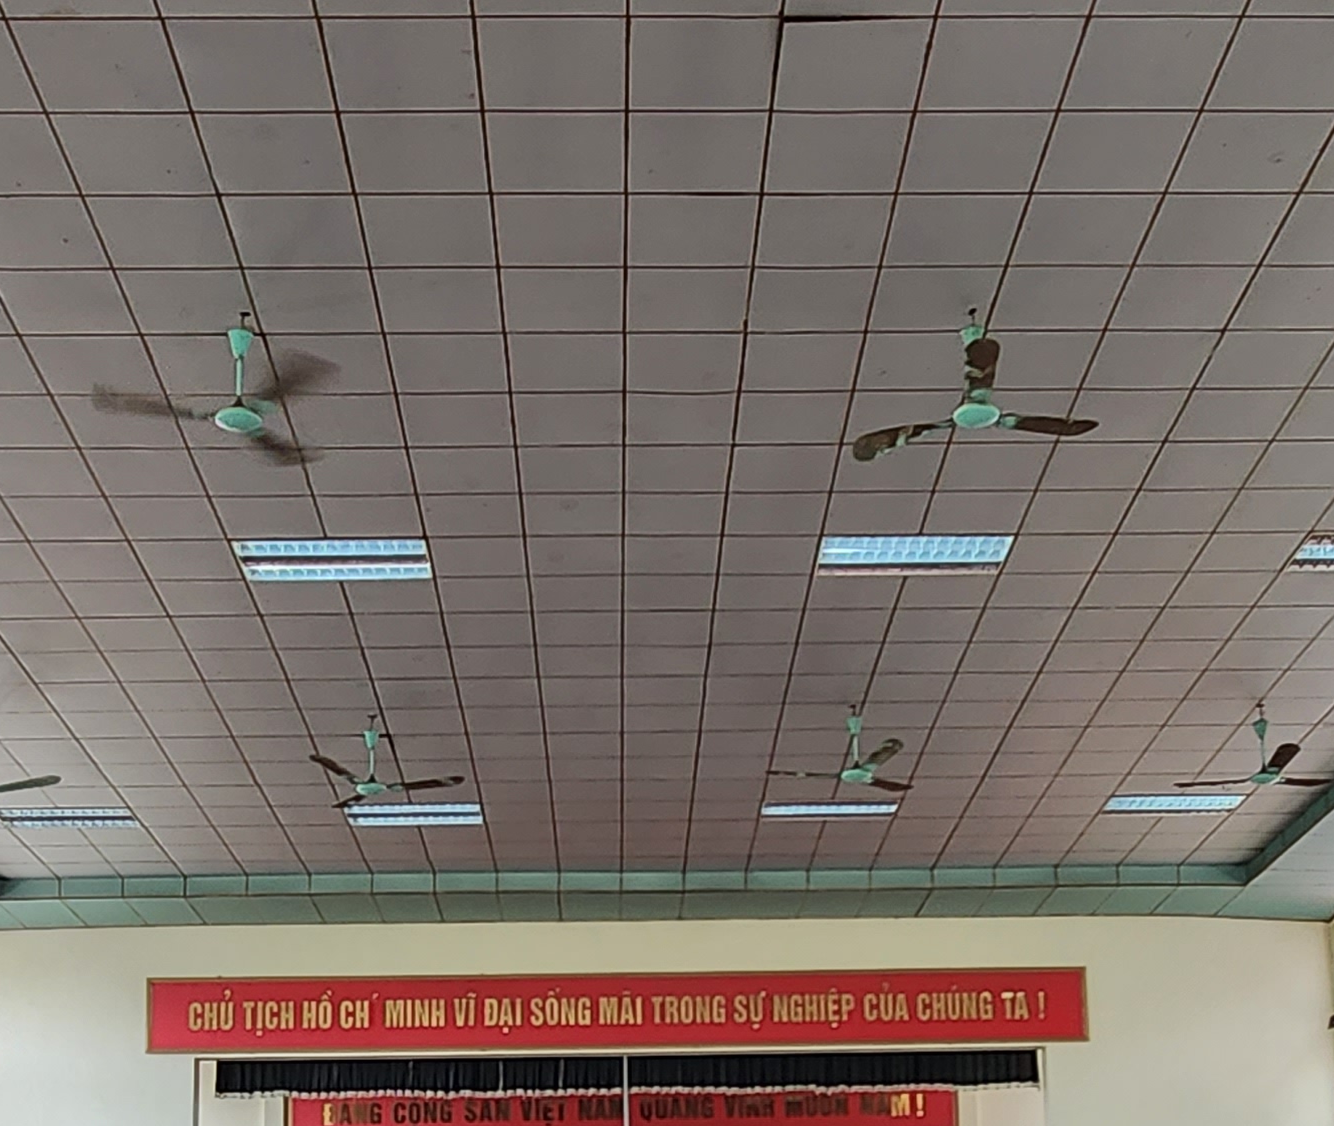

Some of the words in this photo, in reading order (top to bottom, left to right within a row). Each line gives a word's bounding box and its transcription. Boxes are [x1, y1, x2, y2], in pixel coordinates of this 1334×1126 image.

[188, 989, 234, 1031] CHỦ
[243, 1000, 295, 1036] TỊCH
[302, 989, 333, 1030] HỒ
[384, 998, 445, 1028] MINH
[453, 992, 478, 1027] VĨ
[484, 997, 523, 1034] ĐẠI
[530, 987, 591, 1027] SỐNG
[599, 992, 643, 1025] MÃI
[651, 994, 727, 1025] TRONG
[733, 990, 766, 1030] SỰ
[772, 989, 855, 1029] NGHIỆP
[863, 983, 909, 1021] CỦA
[916, 983, 994, 1021] CHÚNG
[1000, 991, 1030, 1020] TA
